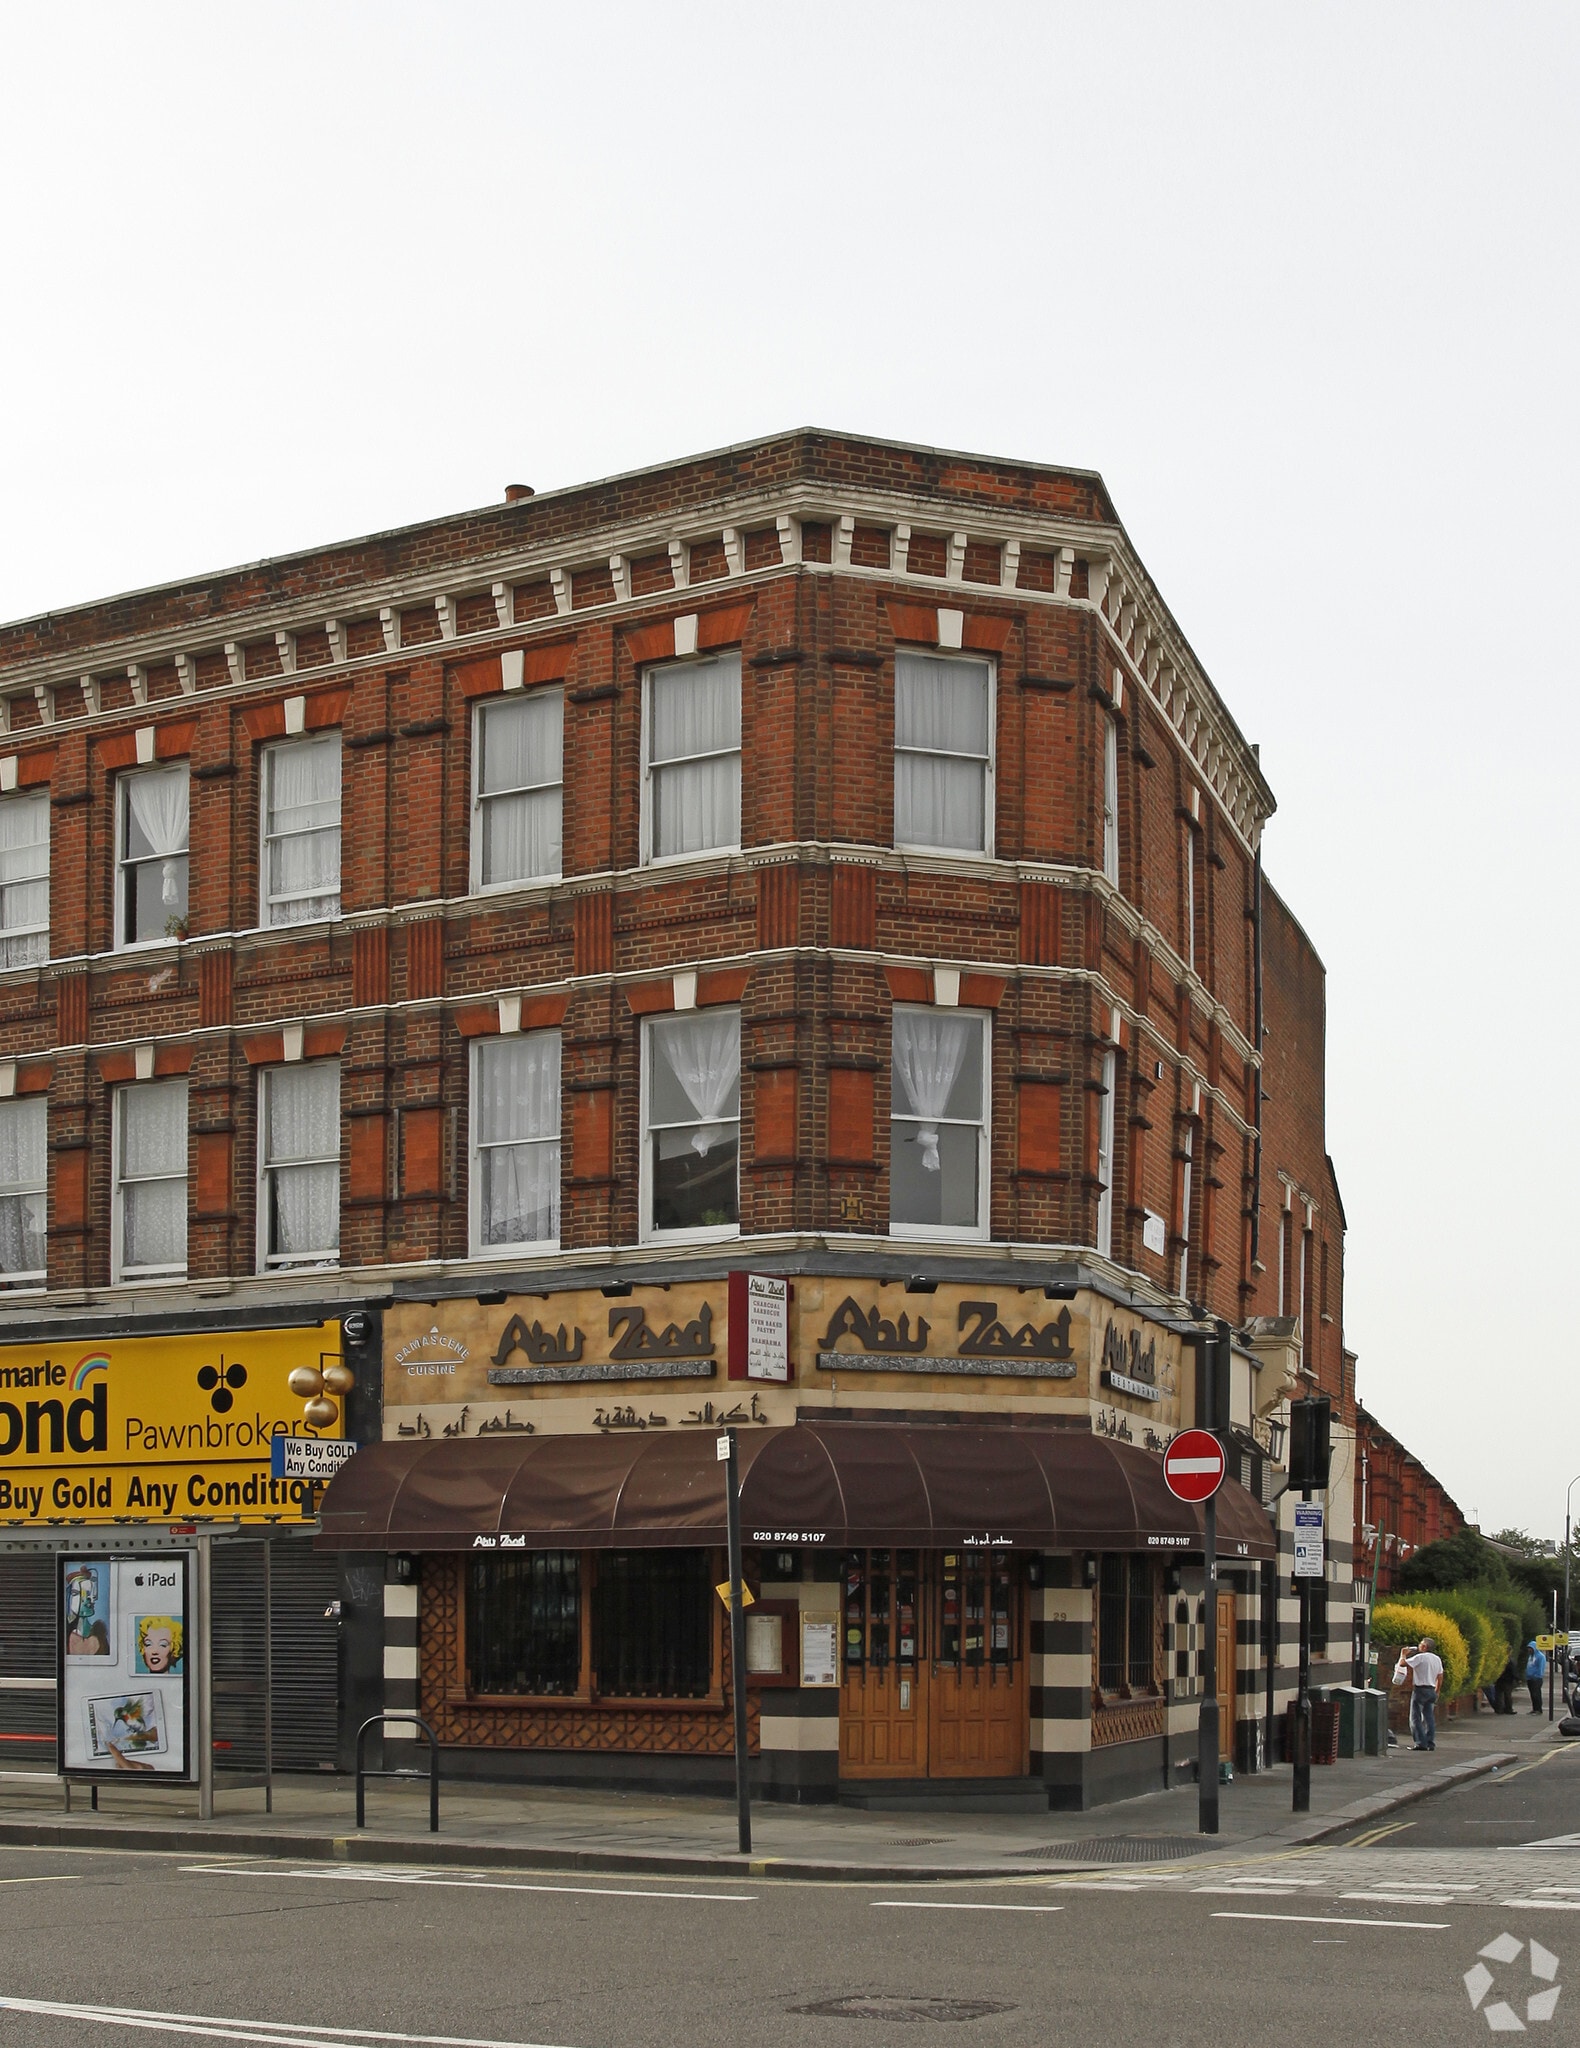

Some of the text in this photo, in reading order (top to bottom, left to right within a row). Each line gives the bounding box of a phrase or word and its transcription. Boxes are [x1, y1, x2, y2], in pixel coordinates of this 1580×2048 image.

[750, 1279, 764, 1293] Abu
[753, 1300, 780, 1310] CHARCOAL
[818, 1296, 931, 1352] Abu
[490, 1312, 586, 1365] Abu
[395, 1334, 470, 1362] DAMASCENE
[0, 1360, 67, 1389] marle
[407, 1365, 456, 1376] CUISINE
[1111, 1373, 1160, 1400] RESTAURANT
[286, 1442, 355, 1460] We Buy GOLD
[286, 1458, 306, 1475] Any
[0, 1479, 44, 1518] Buy
[52, 1477, 112, 1509] Gold
[126, 1476, 179, 1516] Any
[473, 1534, 496, 1547] Abu
[753, 1532, 826, 1542] 020 8749 5107
[1147, 1536, 1191, 1546] 020 8749 5107
[148, 1573, 176, 1587] iPad
[1053, 1611, 1067, 1622] 29
